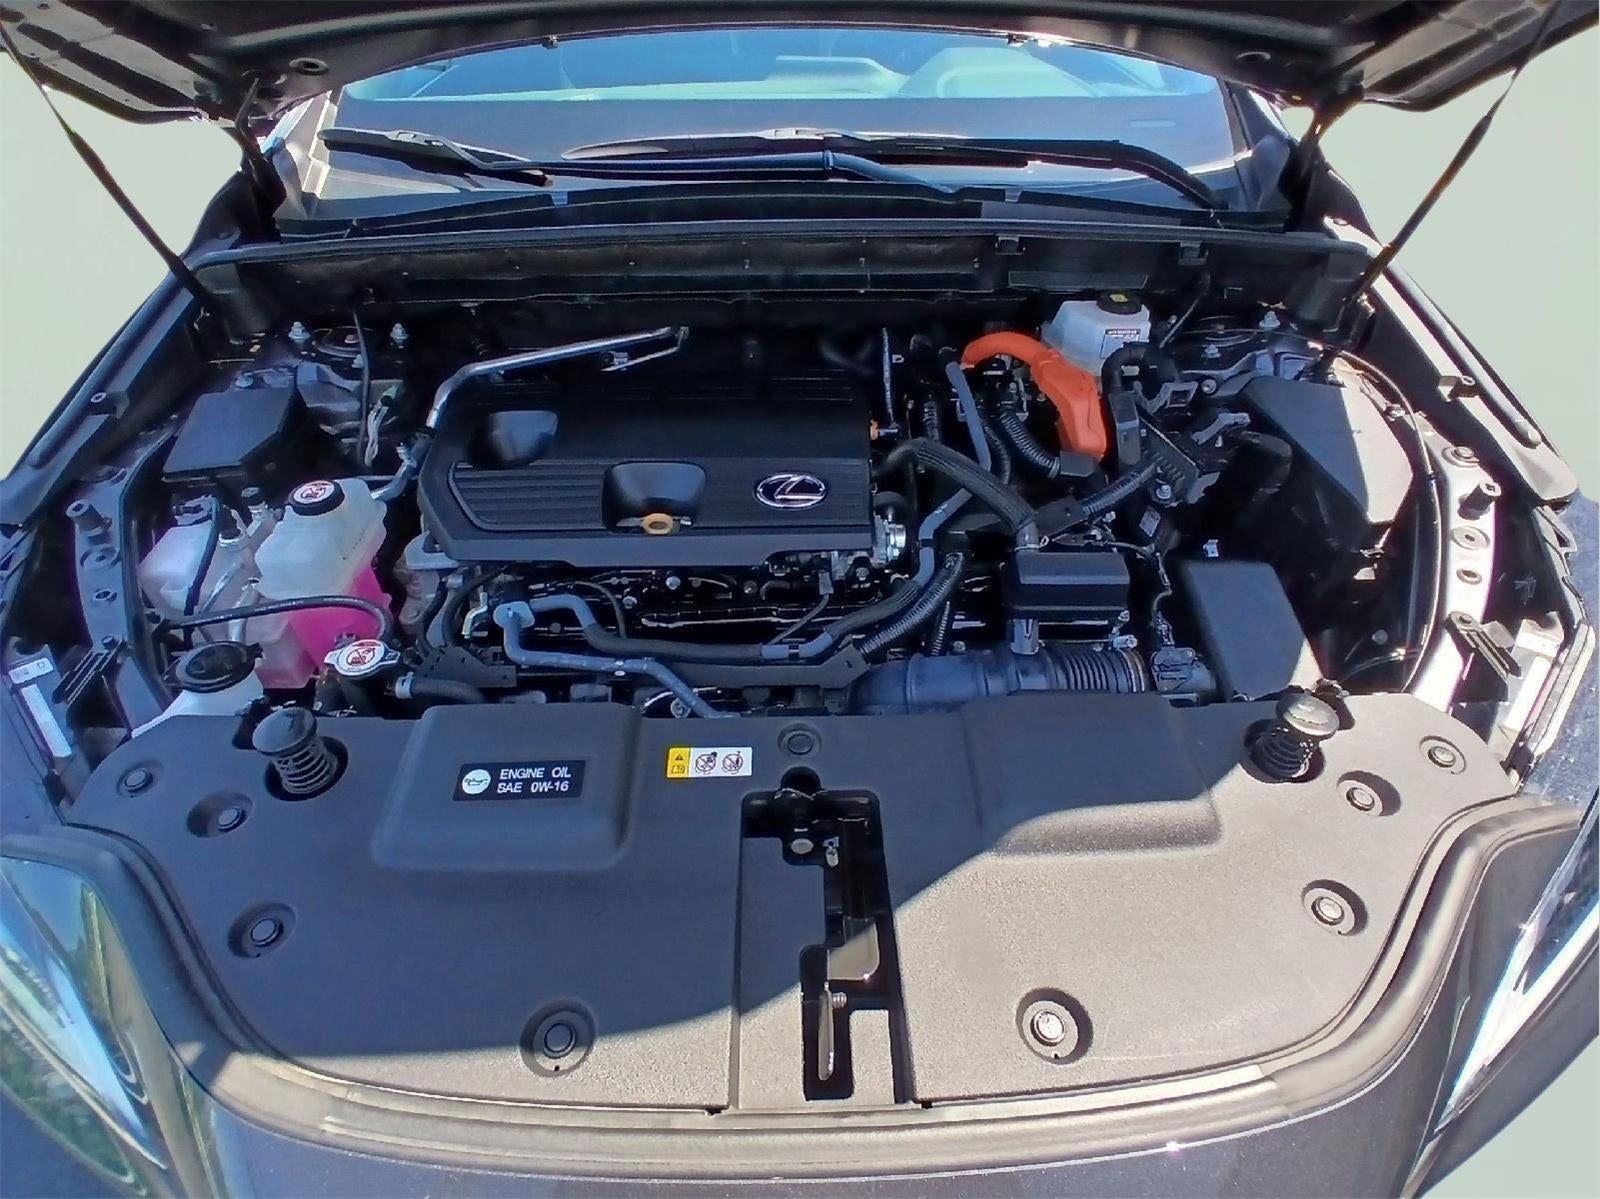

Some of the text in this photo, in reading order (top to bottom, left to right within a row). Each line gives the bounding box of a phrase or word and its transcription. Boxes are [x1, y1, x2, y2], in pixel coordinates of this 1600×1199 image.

[499, 766, 572, 780] ENGINE OIL
[497, 780, 570, 793] SAE 0W-16
